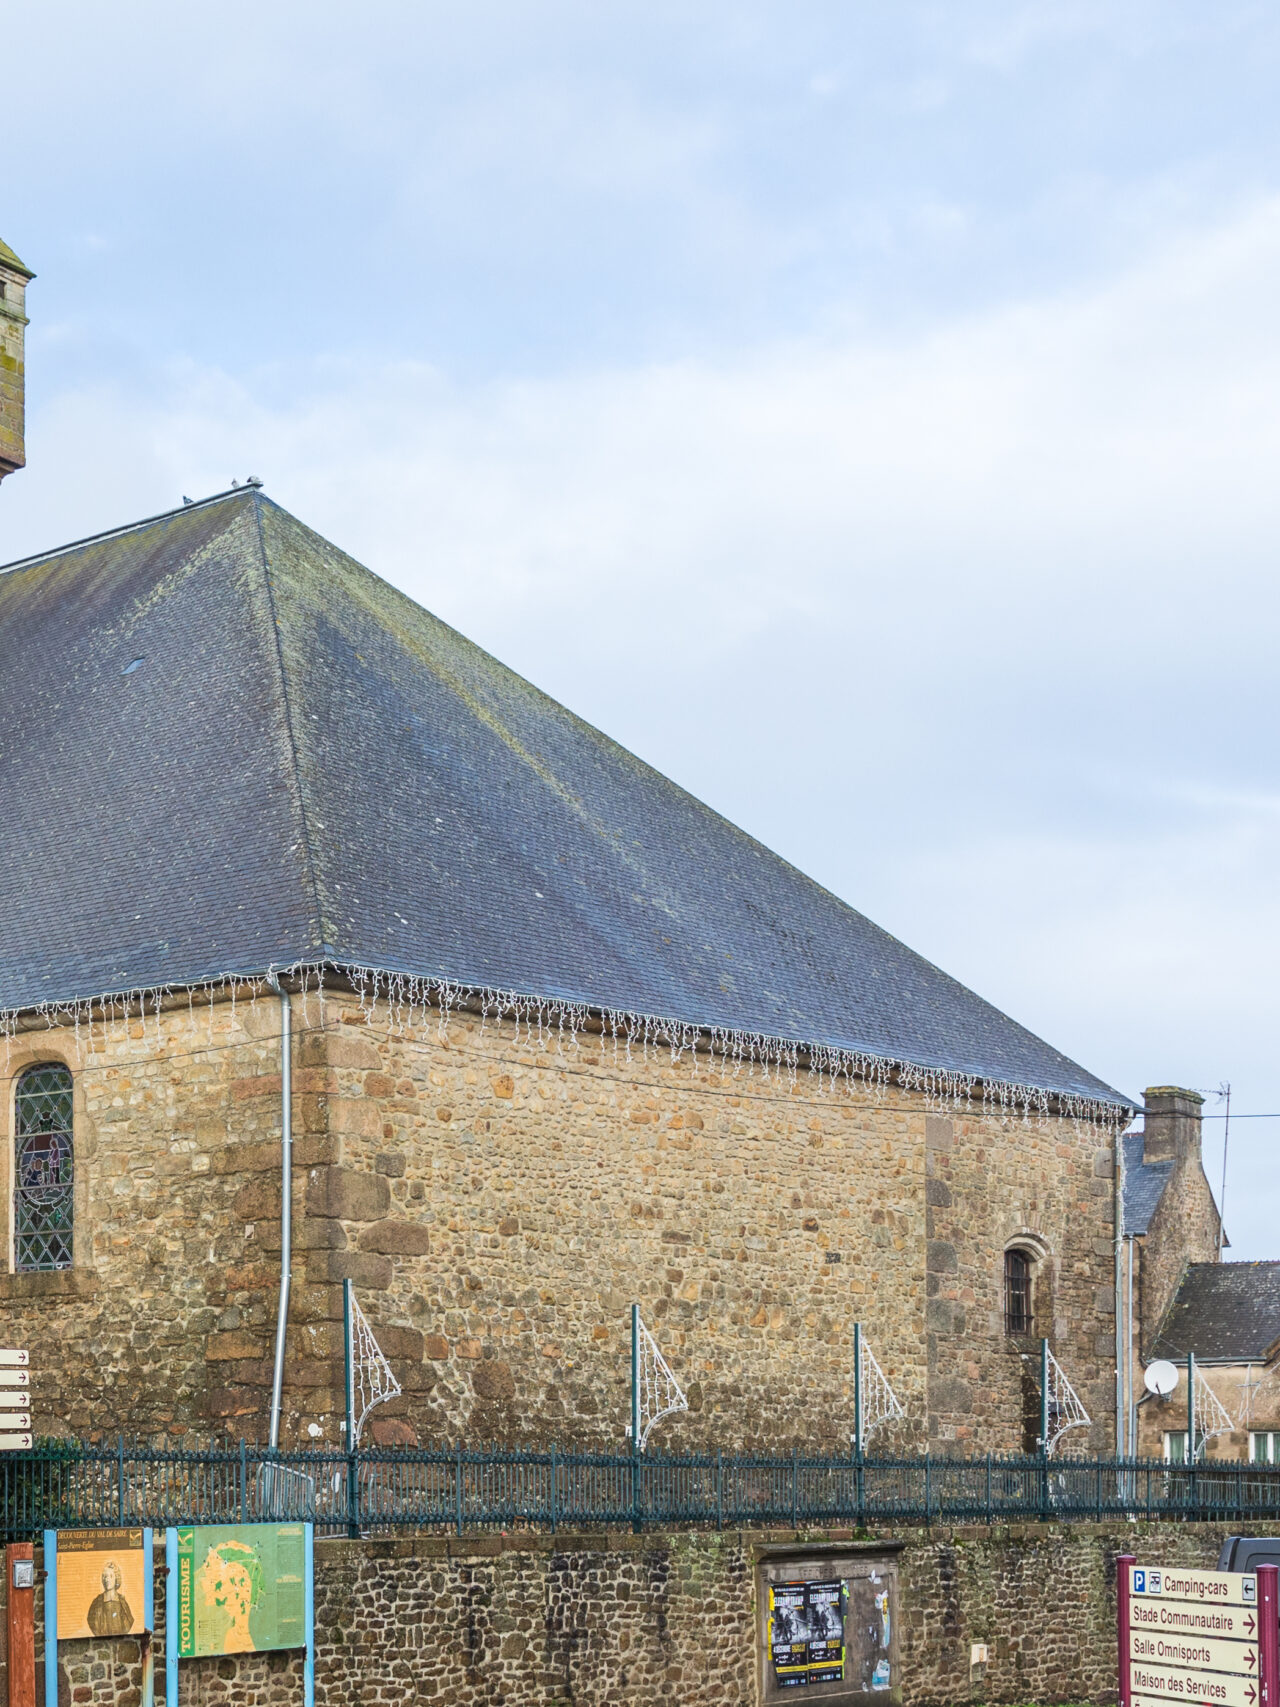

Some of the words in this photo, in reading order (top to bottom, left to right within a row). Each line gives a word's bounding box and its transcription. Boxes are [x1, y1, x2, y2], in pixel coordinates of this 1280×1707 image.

[1164, 1576, 1228, 1598] Camping-cars
[180, 1558, 191, 1652] TOURISME
[1133, 1606, 1158, 1623] Stade
[1160, 1608, 1233, 1630] Communautaire
[1134, 1638, 1155, 1655] Salle
[1157, 1641, 1211, 1662] Omnisports
[1134, 1670, 1165, 1690] Maison
[1167, 1676, 1184, 1692] des
[1186, 1678, 1227, 1698] Services
